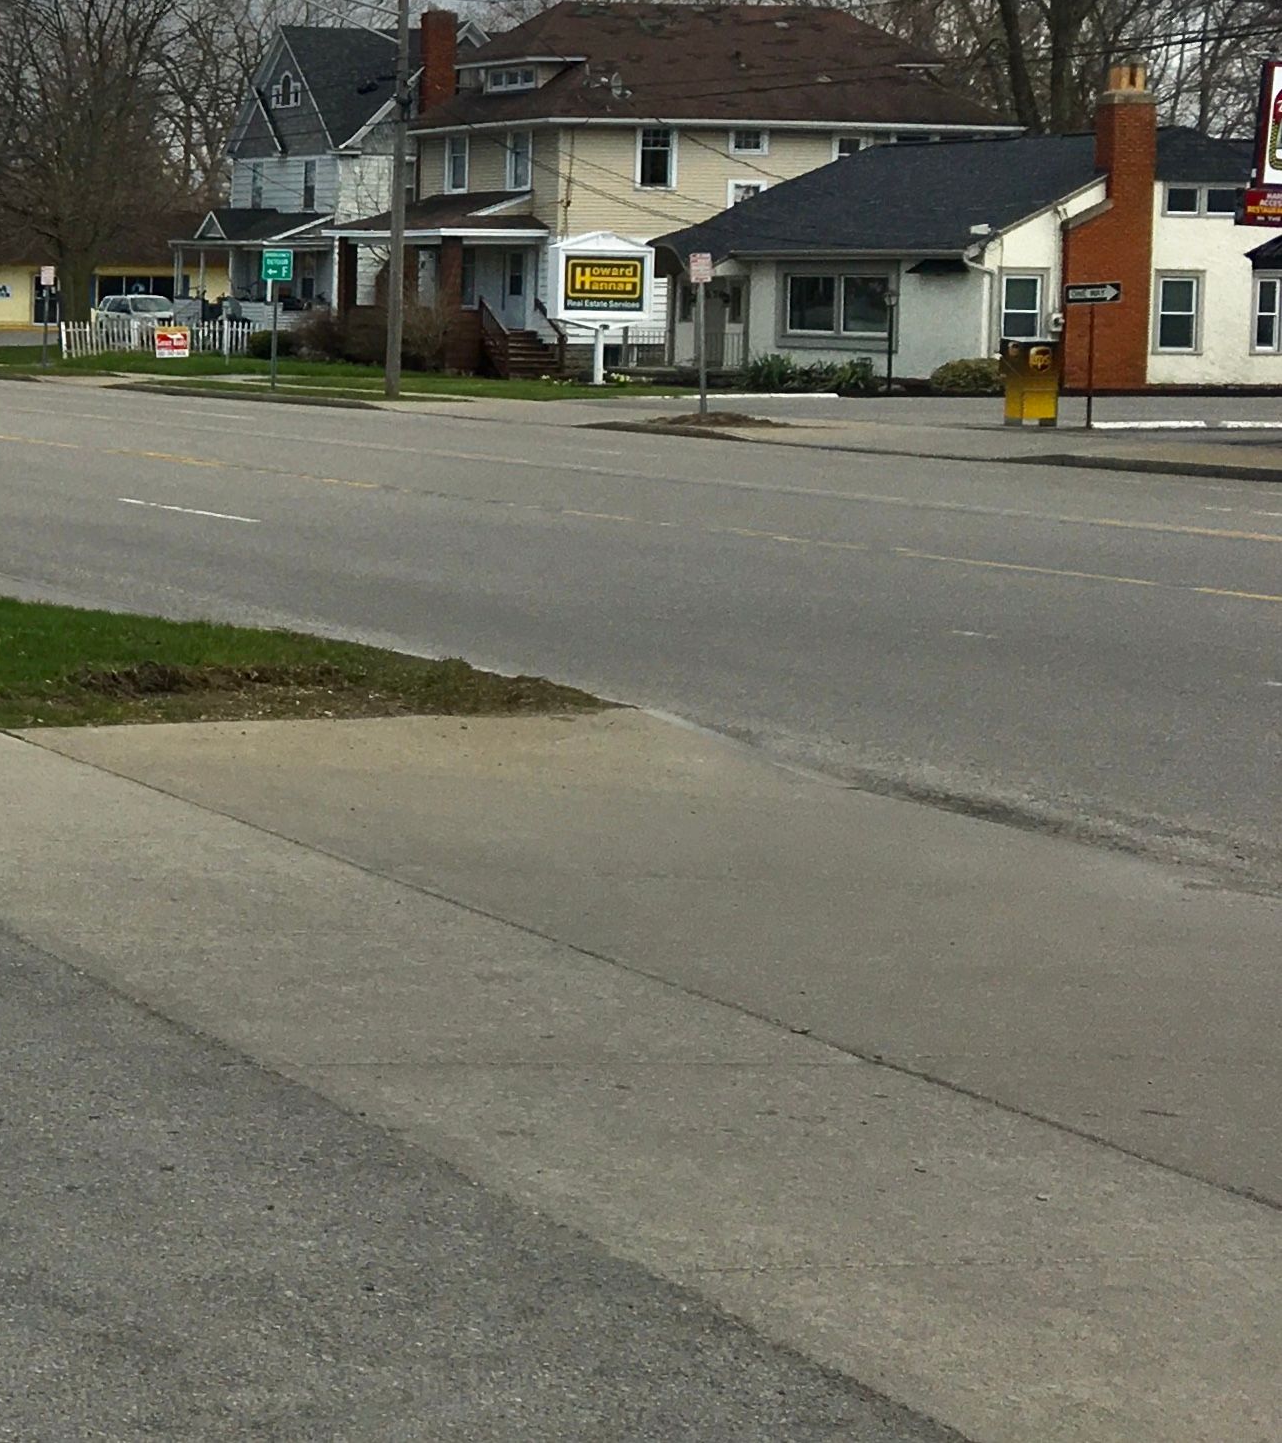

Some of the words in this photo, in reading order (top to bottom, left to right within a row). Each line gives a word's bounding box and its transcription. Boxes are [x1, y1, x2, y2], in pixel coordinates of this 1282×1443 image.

[281, 265, 289, 277] F
[575, 266, 634, 281] Howard
[566, 299, 583, 307] Real
[584, 299, 608, 308] Estate
[608, 300, 640, 309] Services
